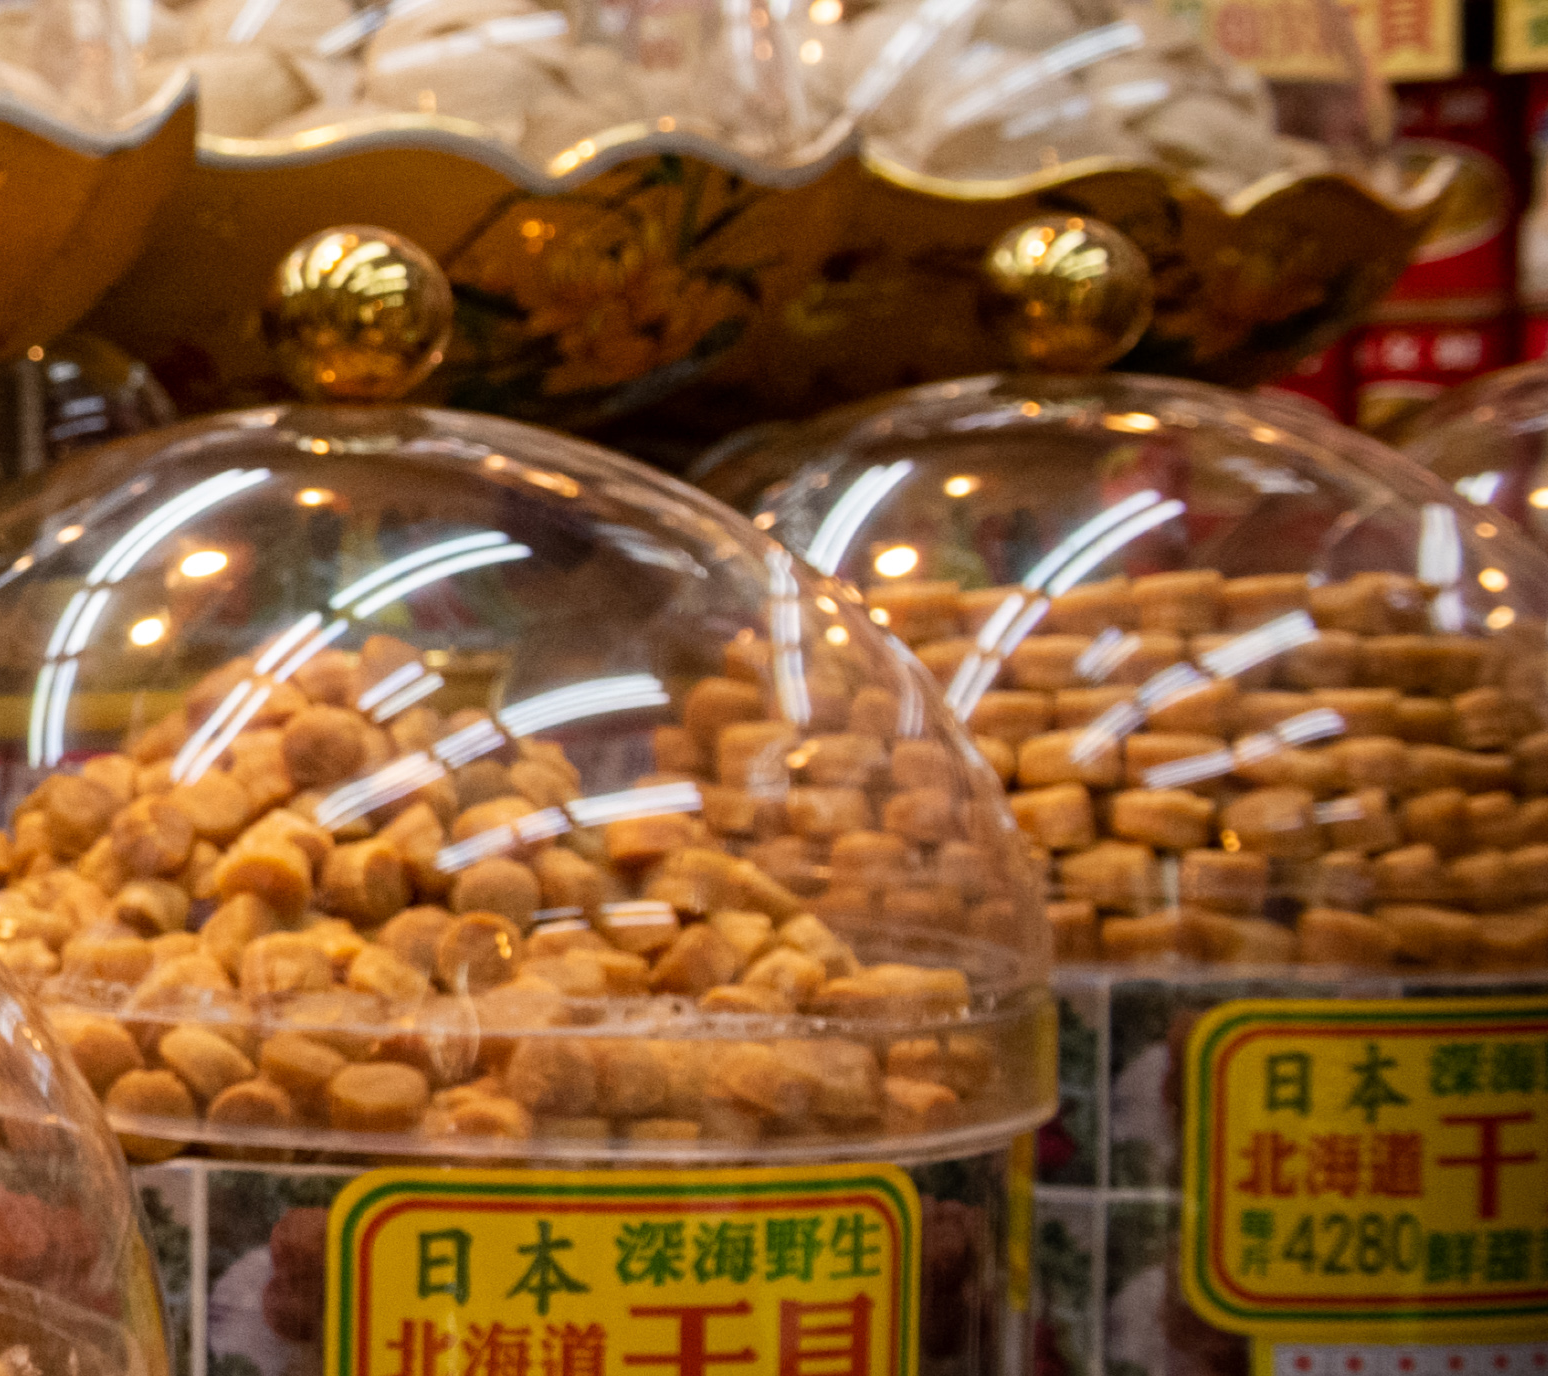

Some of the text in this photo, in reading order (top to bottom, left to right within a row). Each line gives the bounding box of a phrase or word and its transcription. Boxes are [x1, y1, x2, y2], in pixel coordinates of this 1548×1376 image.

[1266, 1043, 1411, 1123] 日本
[416, 1214, 882, 1315] 日本 深海野生
[1283, 1212, 1423, 1277] 4280
